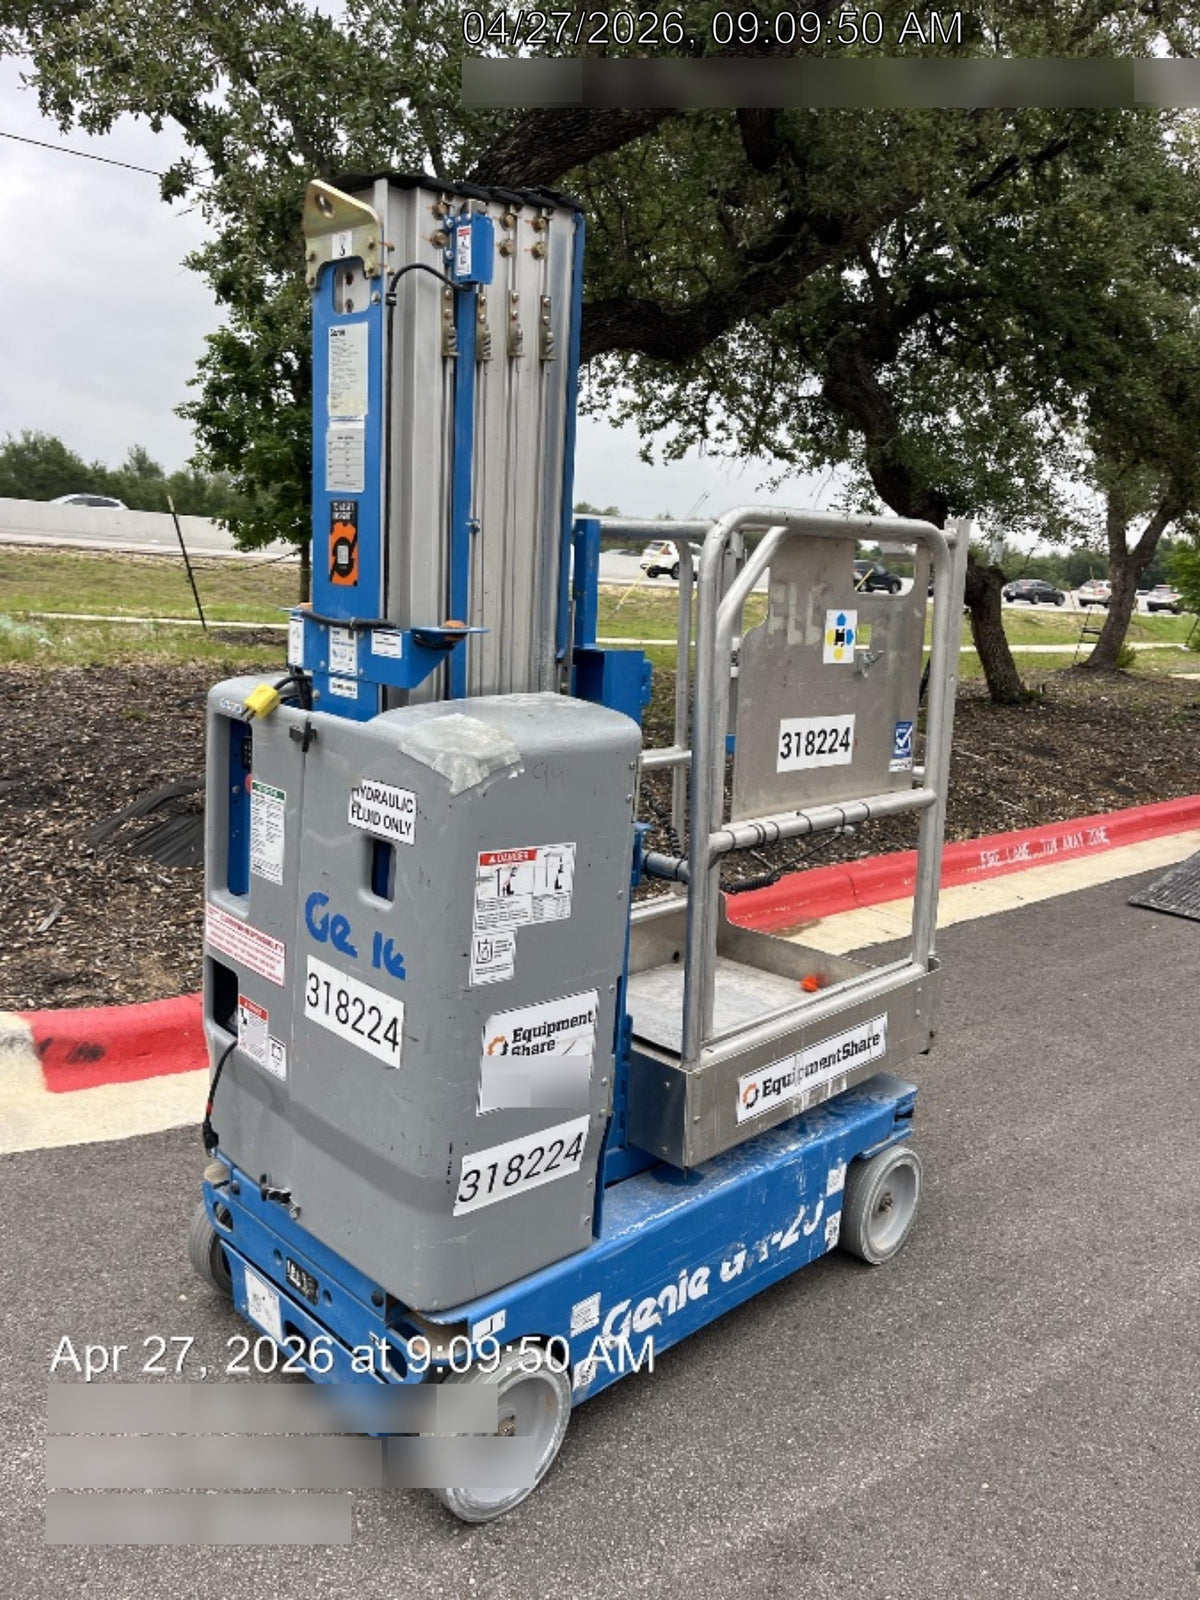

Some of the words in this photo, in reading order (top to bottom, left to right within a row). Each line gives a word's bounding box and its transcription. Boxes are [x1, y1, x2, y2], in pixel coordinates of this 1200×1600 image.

[779, 727, 851, 760] 318224
[351, 785, 413, 813] HYDRAULIC
[351, 801, 381, 826] FLUID
[383, 815, 412, 836] ONLY
[306, 972, 400, 1053] 318224
[511, 1010, 593, 1044] Equipment
[458, 1131, 584, 1203] 318224
[601, 1266, 711, 1348] Genie
